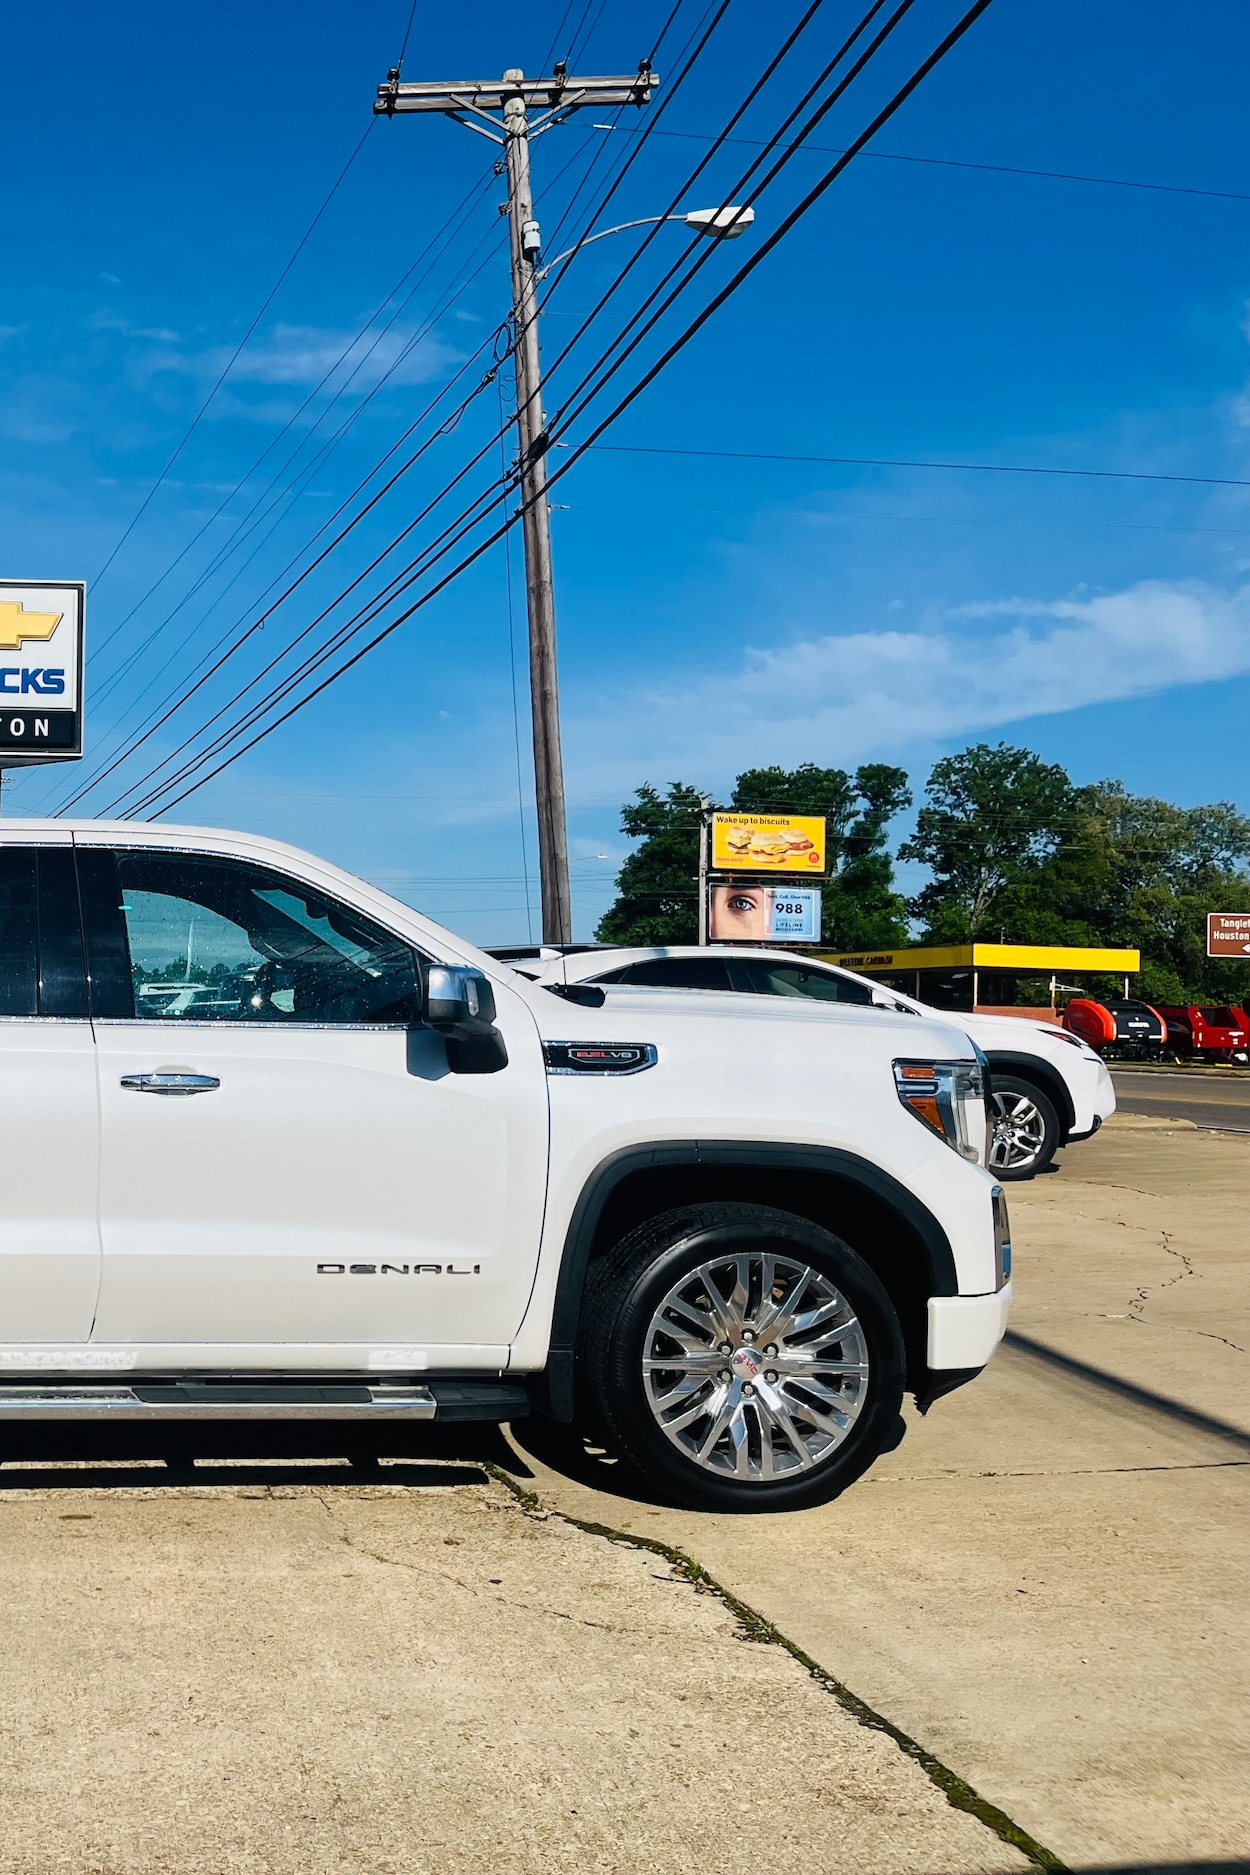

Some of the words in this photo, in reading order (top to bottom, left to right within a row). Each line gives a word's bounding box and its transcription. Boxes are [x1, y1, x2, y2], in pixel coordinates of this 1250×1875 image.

[716, 816, 737, 824] Wake
[739, 818, 749, 826] up
[759, 817, 790, 826] biscuits
[775, 903, 803, 914] 988
[1213, 931, 1250, 941] Houston
[317, 1264, 481, 1274] DENALI
